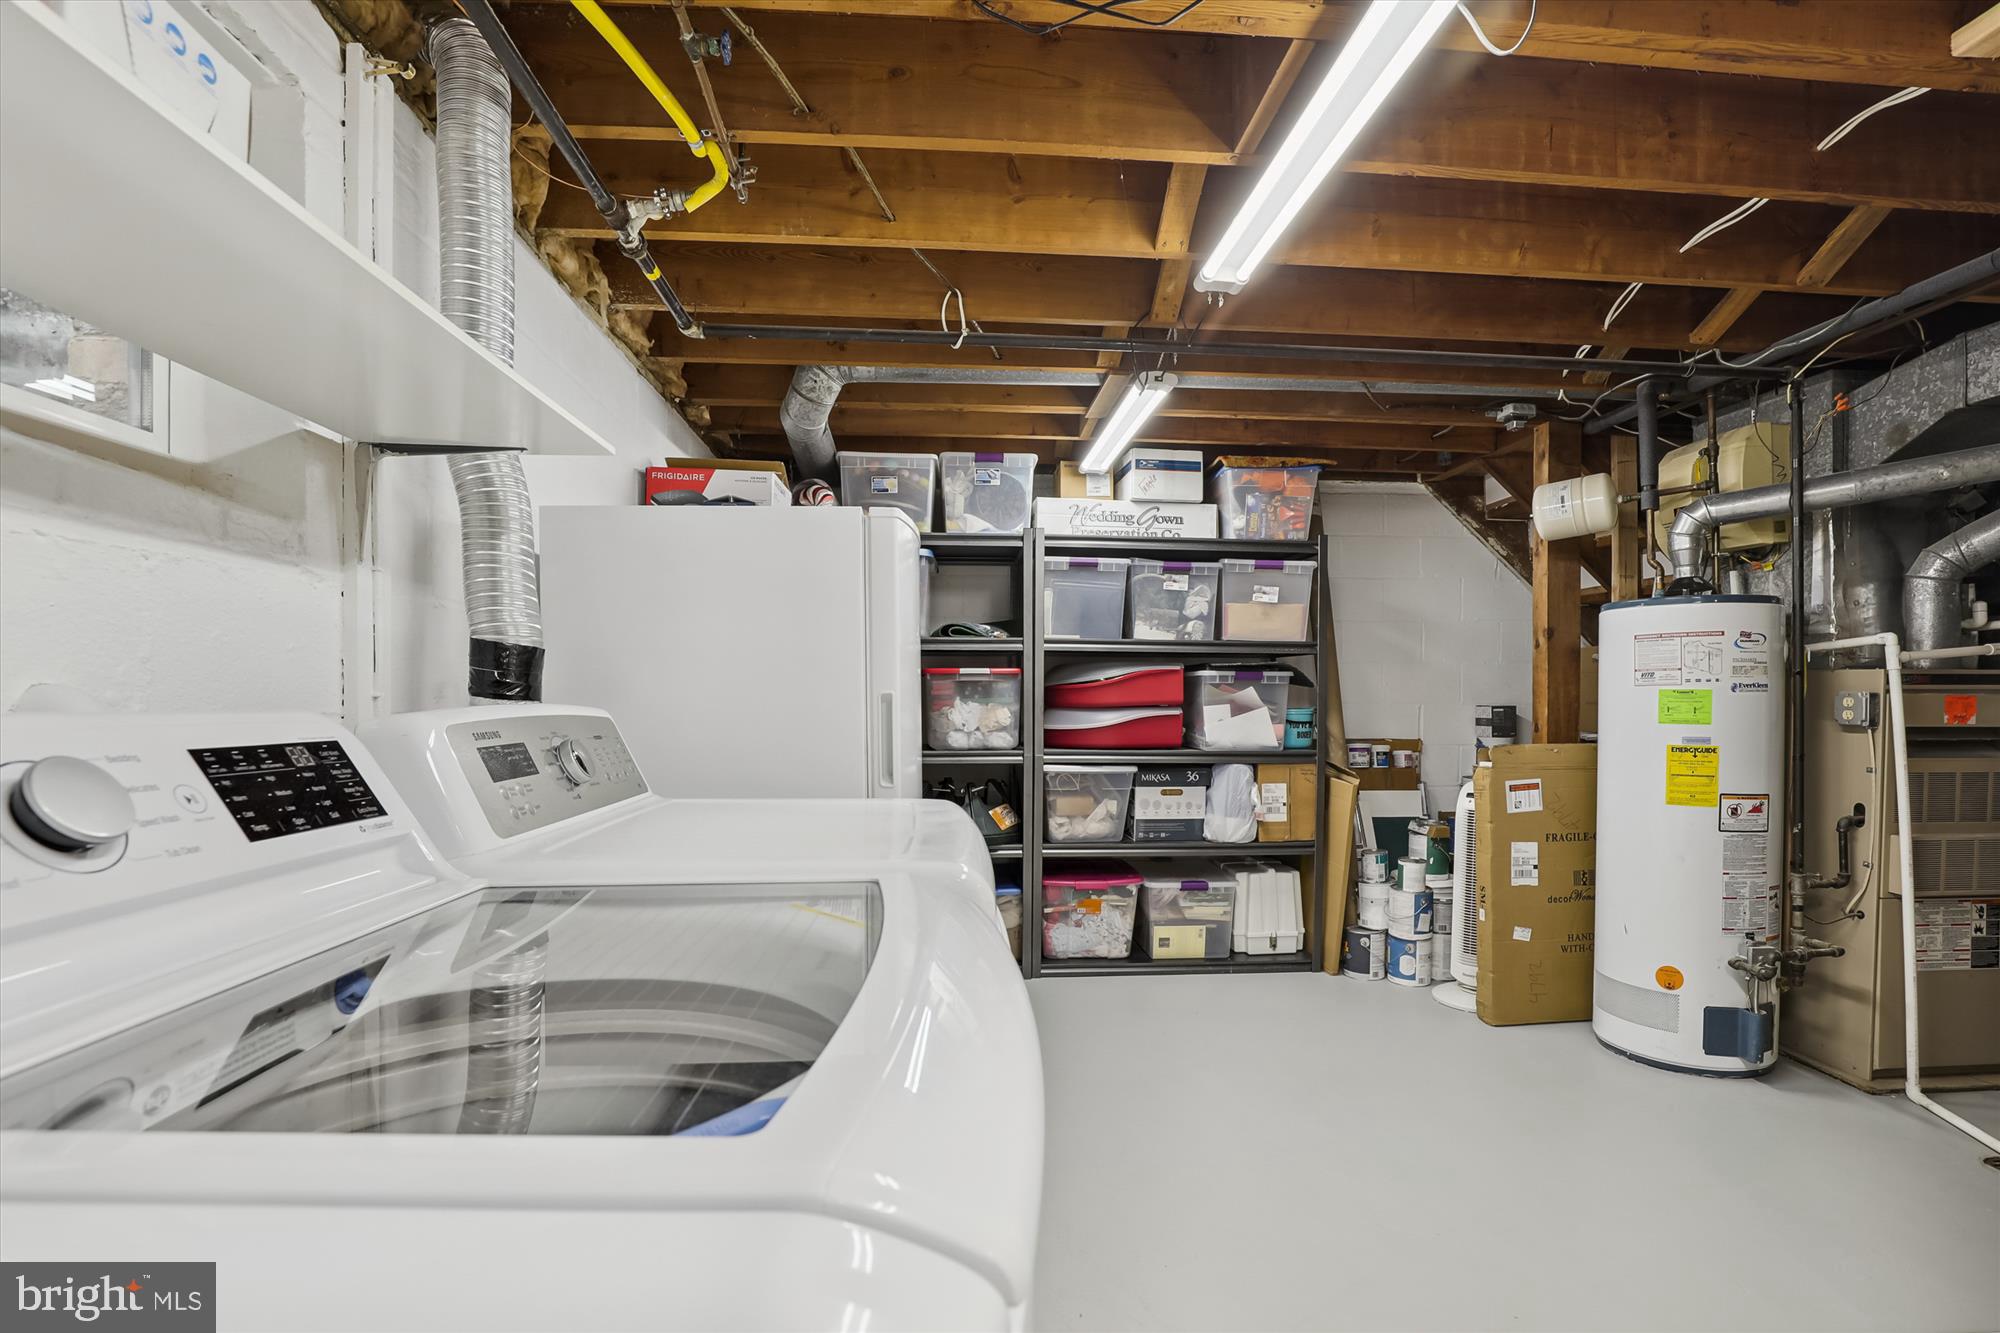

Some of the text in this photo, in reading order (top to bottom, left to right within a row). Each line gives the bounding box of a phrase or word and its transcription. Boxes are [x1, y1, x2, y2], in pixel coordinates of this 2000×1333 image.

[652, 472, 705, 481] FRIGIDAIRE
[1069, 503, 1184, 531] Wedding Gown
[472, 731, 501, 741] SAMSUNG
[1671, 747, 1717, 755] ENERGYGUIDE
[1141, 771, 1199, 782] MIKASA 36
